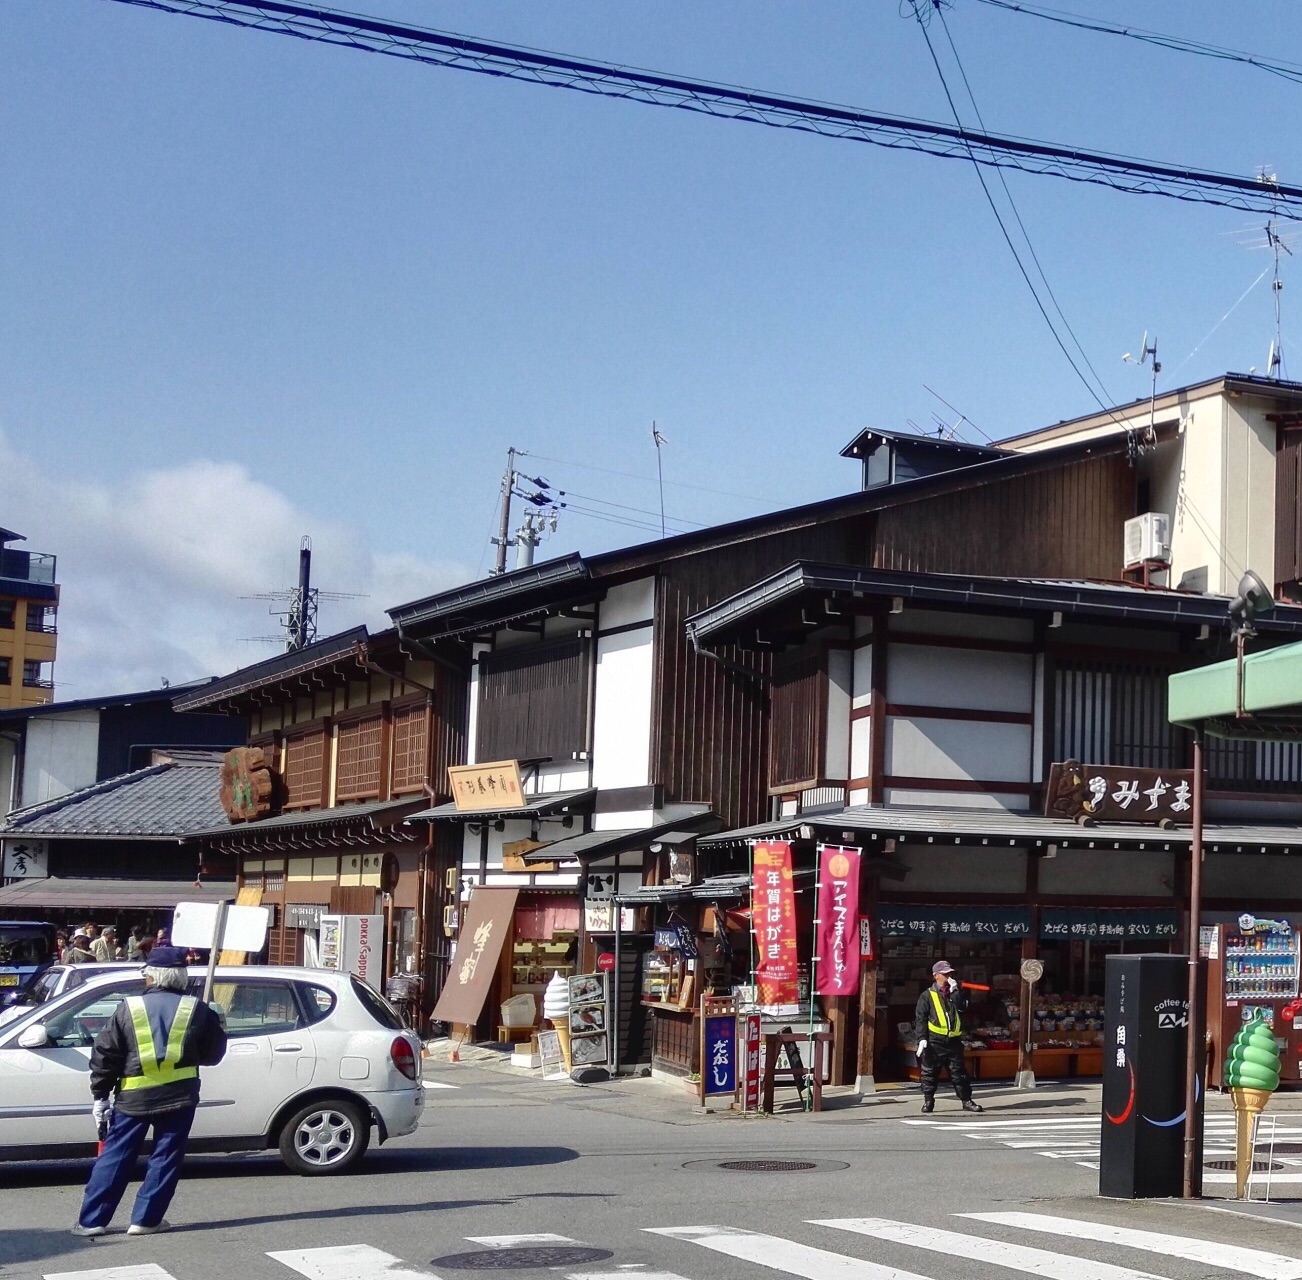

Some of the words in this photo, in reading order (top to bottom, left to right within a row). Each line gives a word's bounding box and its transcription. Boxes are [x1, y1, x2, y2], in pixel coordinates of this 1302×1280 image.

[766, 871, 783, 959] 年賀はがき
[833, 880, 848, 989] アイスまんじゅう
[908, 921, 926, 932] 切手
[974, 921, 999, 933] 宝くじ
[1004, 922, 1029, 933] だがし
[1044, 923, 1069, 934] たばこ
[1071, 923, 1088, 935] 切手
[1128, 923, 1150, 934] 宝くじ
[1155, 924, 1178, 935] だがし
[1154, 998, 1181, 1012] coffee
[713, 1039, 729, 1086] だがし
[748, 1020, 759, 1101] たばこ
